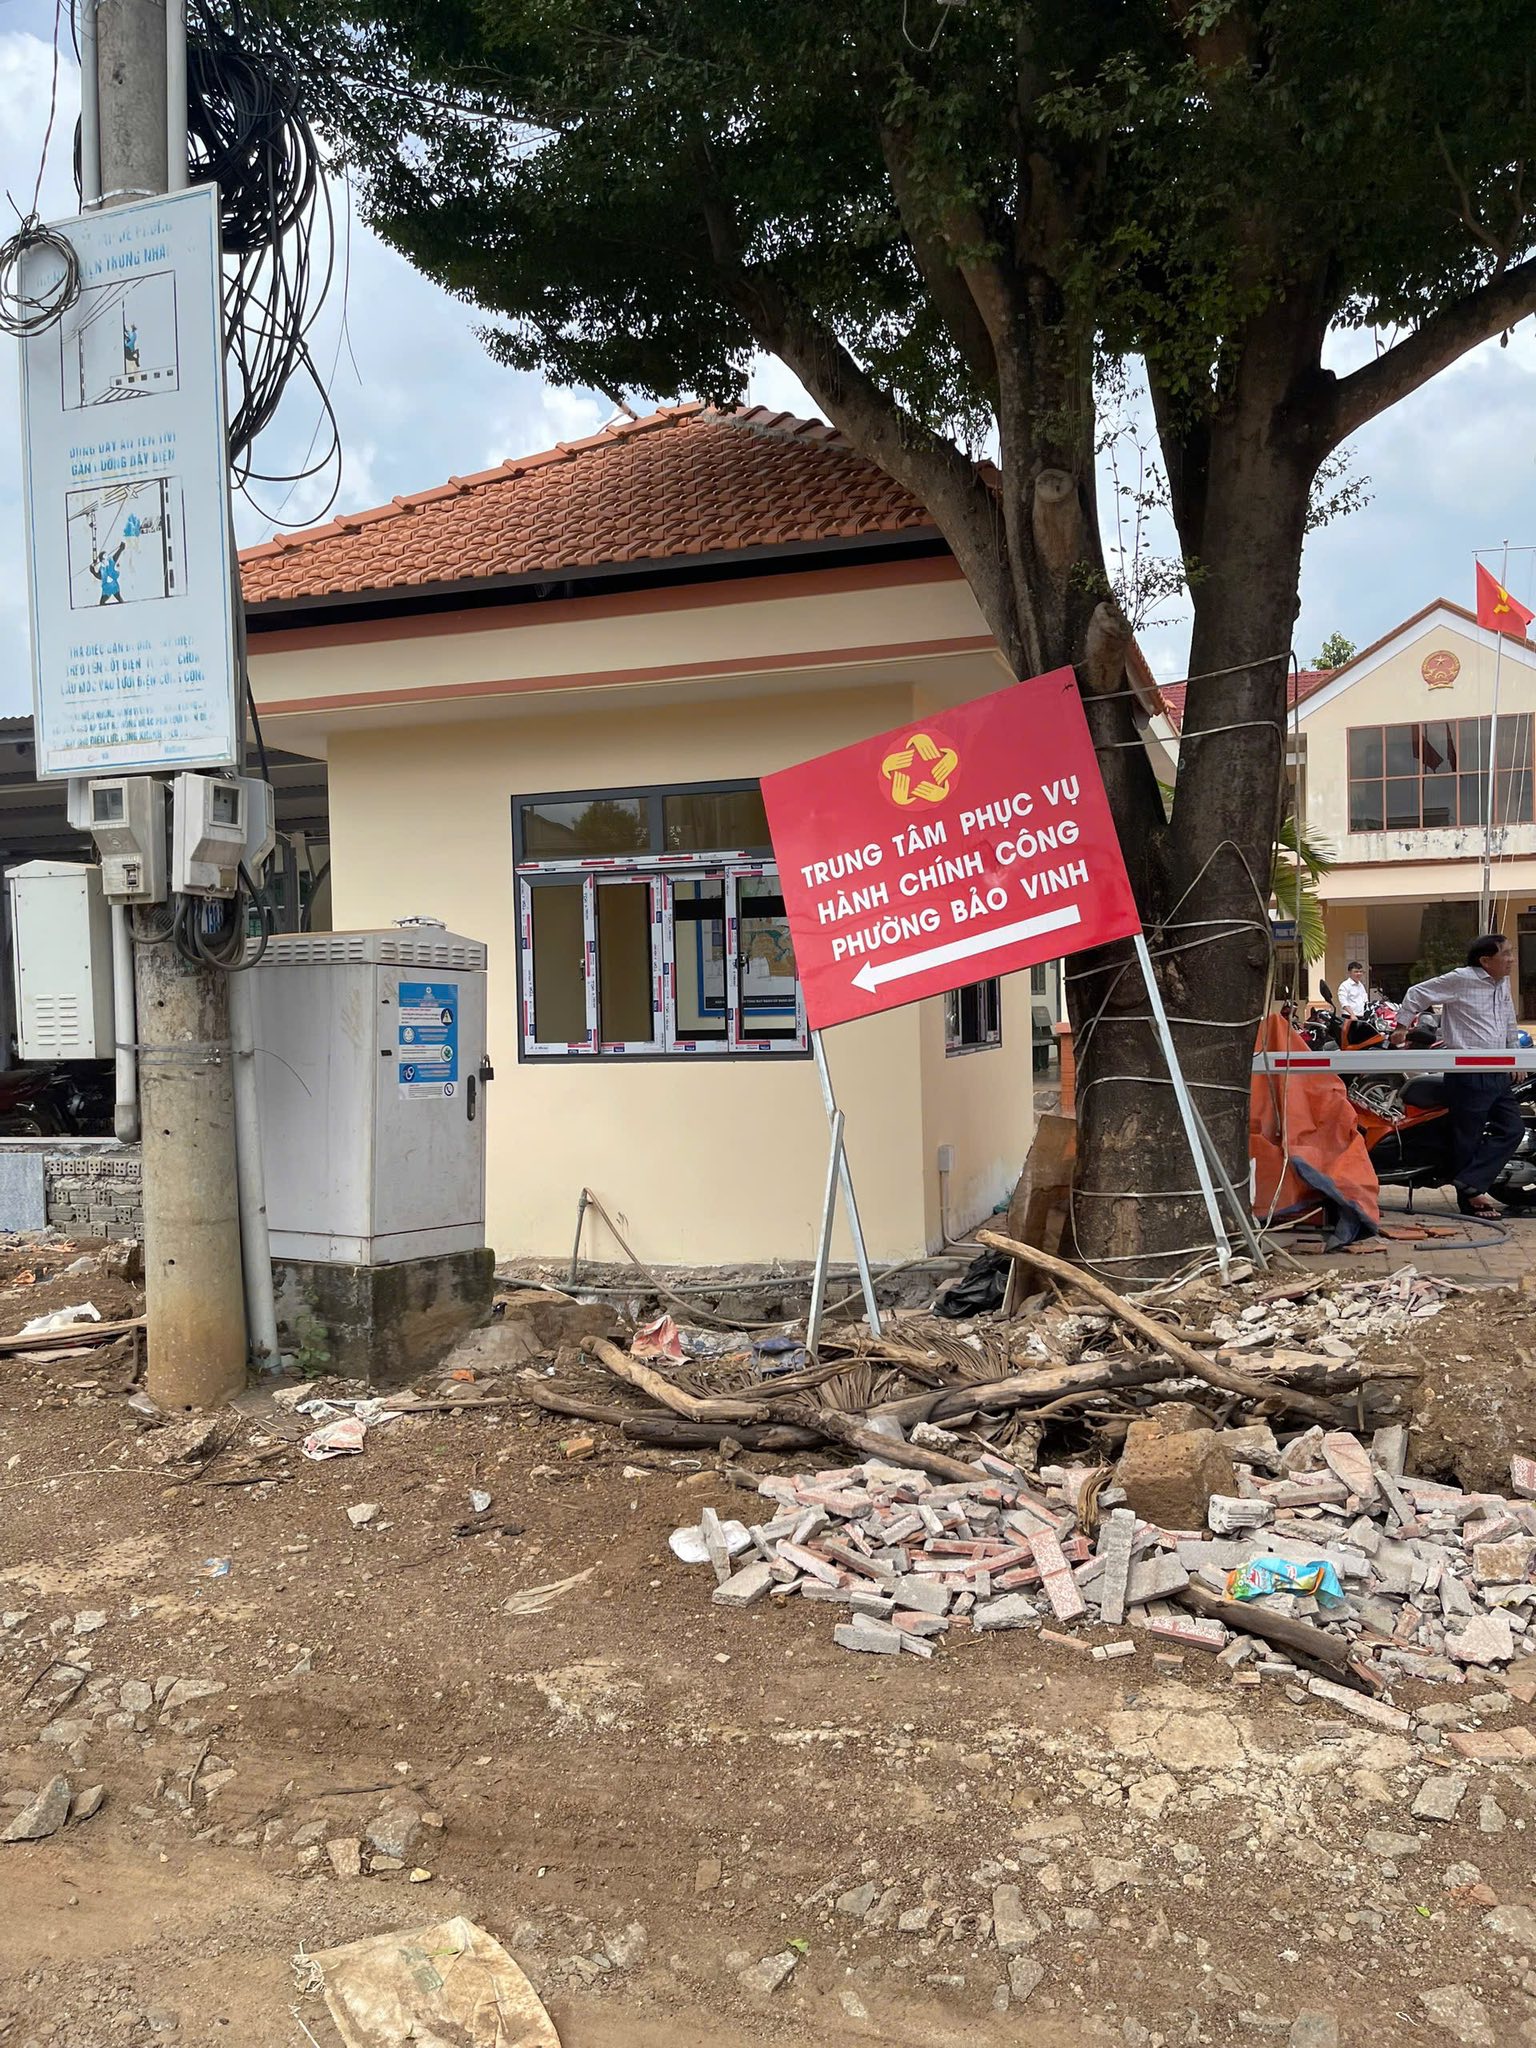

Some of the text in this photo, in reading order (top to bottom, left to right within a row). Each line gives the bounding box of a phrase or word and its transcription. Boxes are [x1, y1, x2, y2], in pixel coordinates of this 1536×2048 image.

[800, 774, 1081, 889] TRUNG TÂM PHỤC VỤ
[817, 820, 1080, 925] HÀNH CHÍNH CÔNG
[831, 859, 1090, 962] PHƯỜNG BẢO VINH
